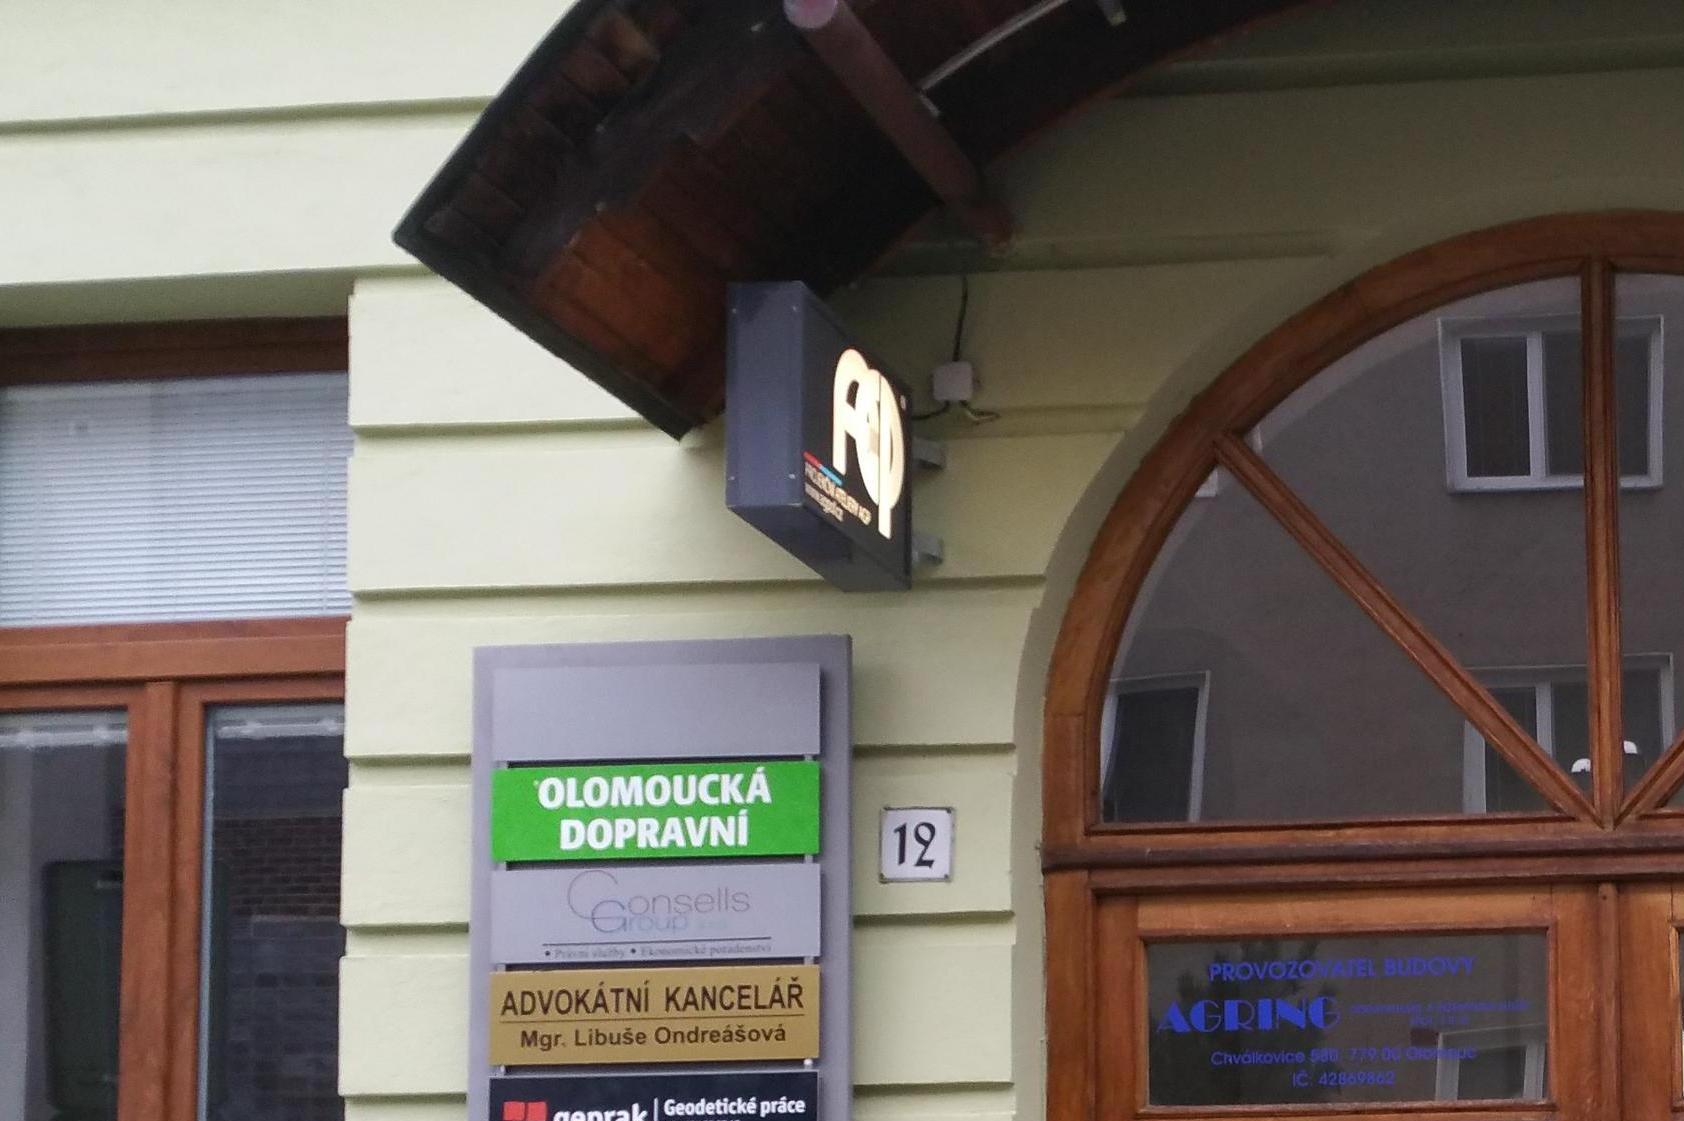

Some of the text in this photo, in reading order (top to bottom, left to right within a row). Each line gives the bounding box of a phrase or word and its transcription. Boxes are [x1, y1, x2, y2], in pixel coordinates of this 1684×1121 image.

[537, 766, 772, 809] OLOMOUCKÁ
[560, 809, 748, 850] DOPRAVNÍ
[893, 822, 936, 868] 12
[1209, 956, 1476, 982] PROVOZOVATEL BUDOVY
[501, 976, 804, 1017] ADVOKÁTNÍ KANCELÁŘ
[1157, 996, 1342, 1033] AGRING
[520, 1024, 786, 1051] Mgr. Libuše Ondreášová
[663, 1096, 806, 1118] Geodetické práce
